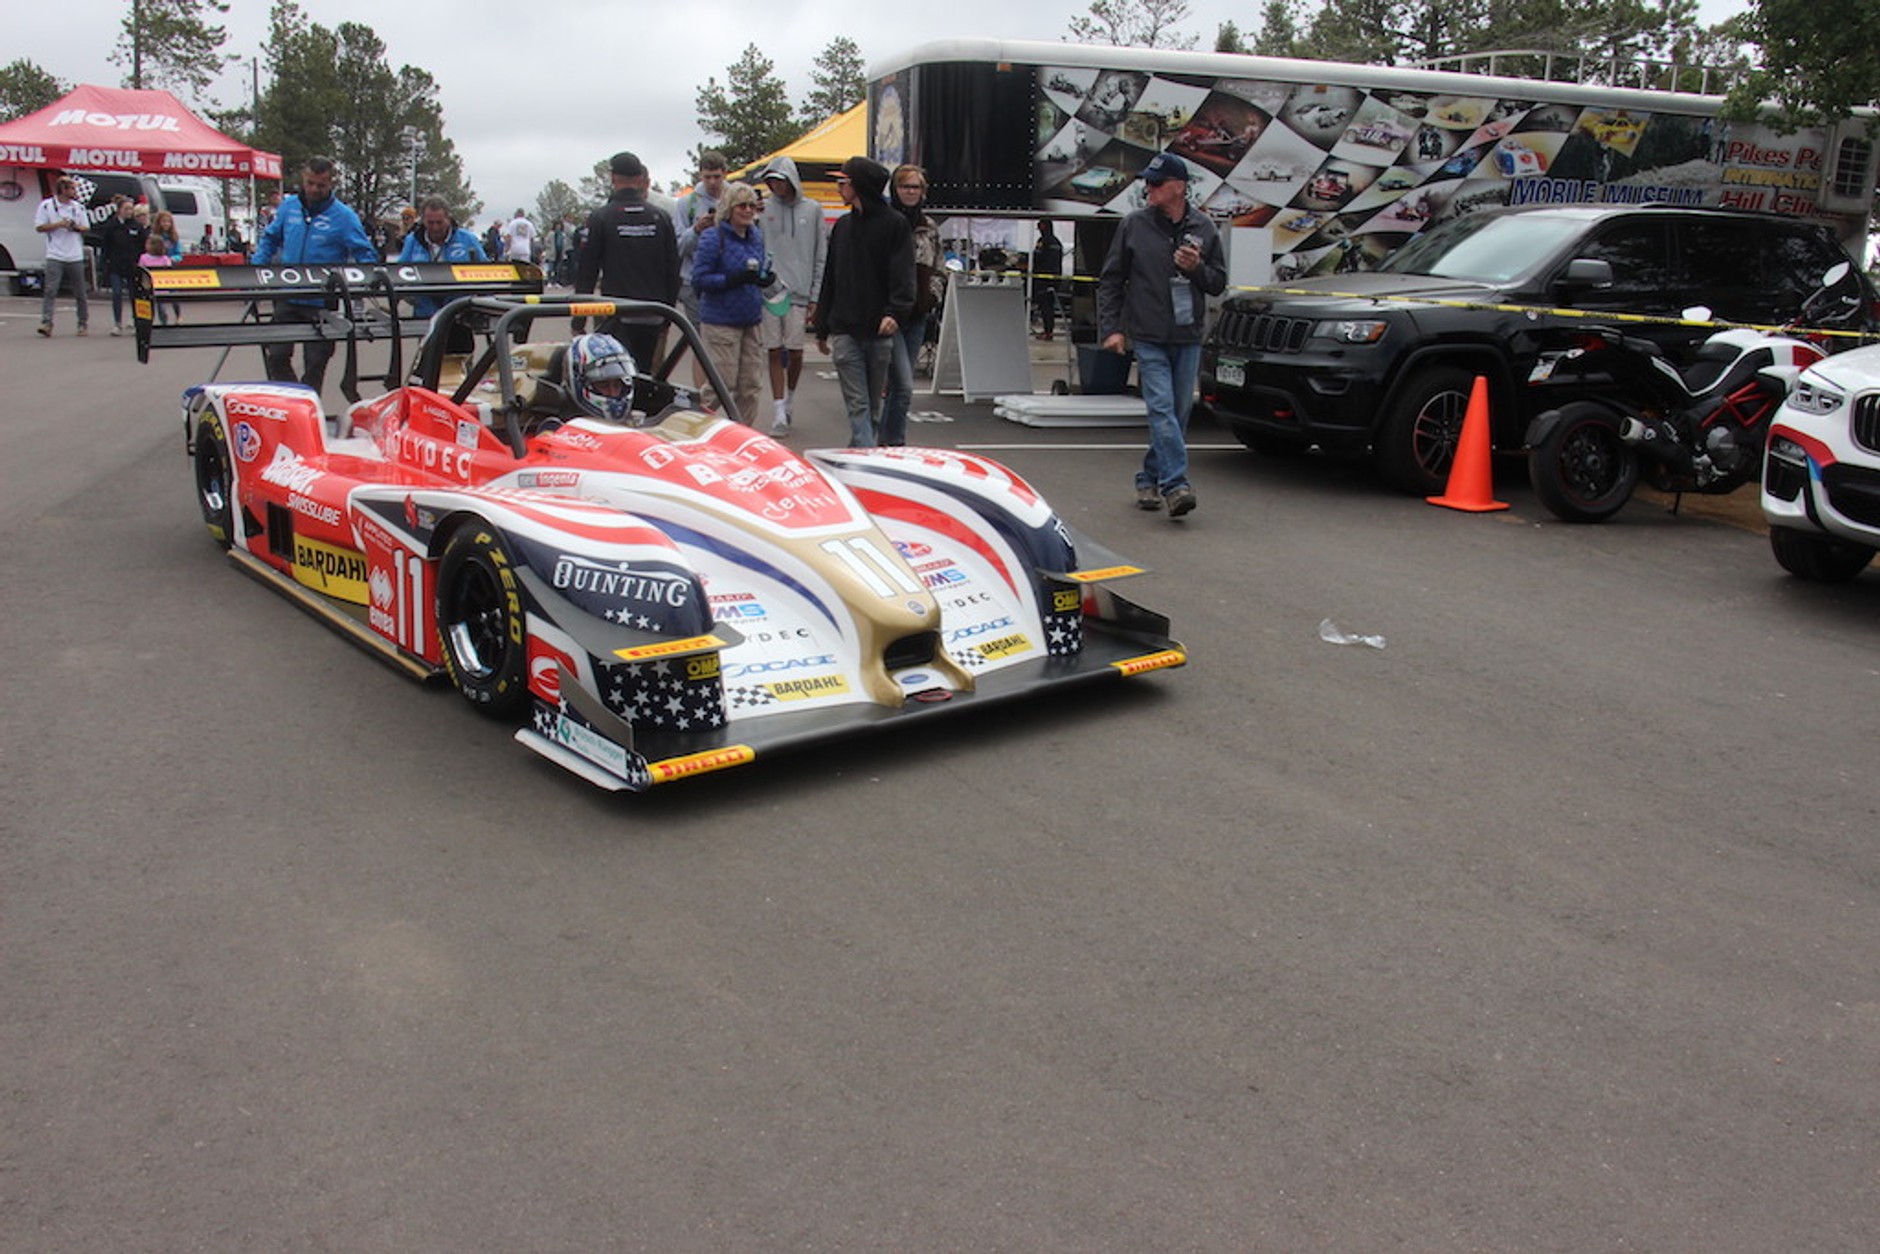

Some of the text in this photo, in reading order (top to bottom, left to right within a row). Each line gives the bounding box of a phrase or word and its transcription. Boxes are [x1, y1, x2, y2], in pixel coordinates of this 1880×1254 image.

[49, 110, 181, 132] MOTUL
[68, 149, 142, 167] MOTUL
[163, 152, 235, 170] MOTUL
[1726, 141, 1789, 166] Pikes
[1513, 178, 1597, 205] MOBILE
[819, 536, 922, 598] 11
[553, 560, 689, 608] QUINTING
[394, 548, 425, 655] 11
[1123, 653, 1179, 672] PIRELLI
[774, 676, 843, 698] BARDAHL
[658, 748, 746, 777] PIRELLI
